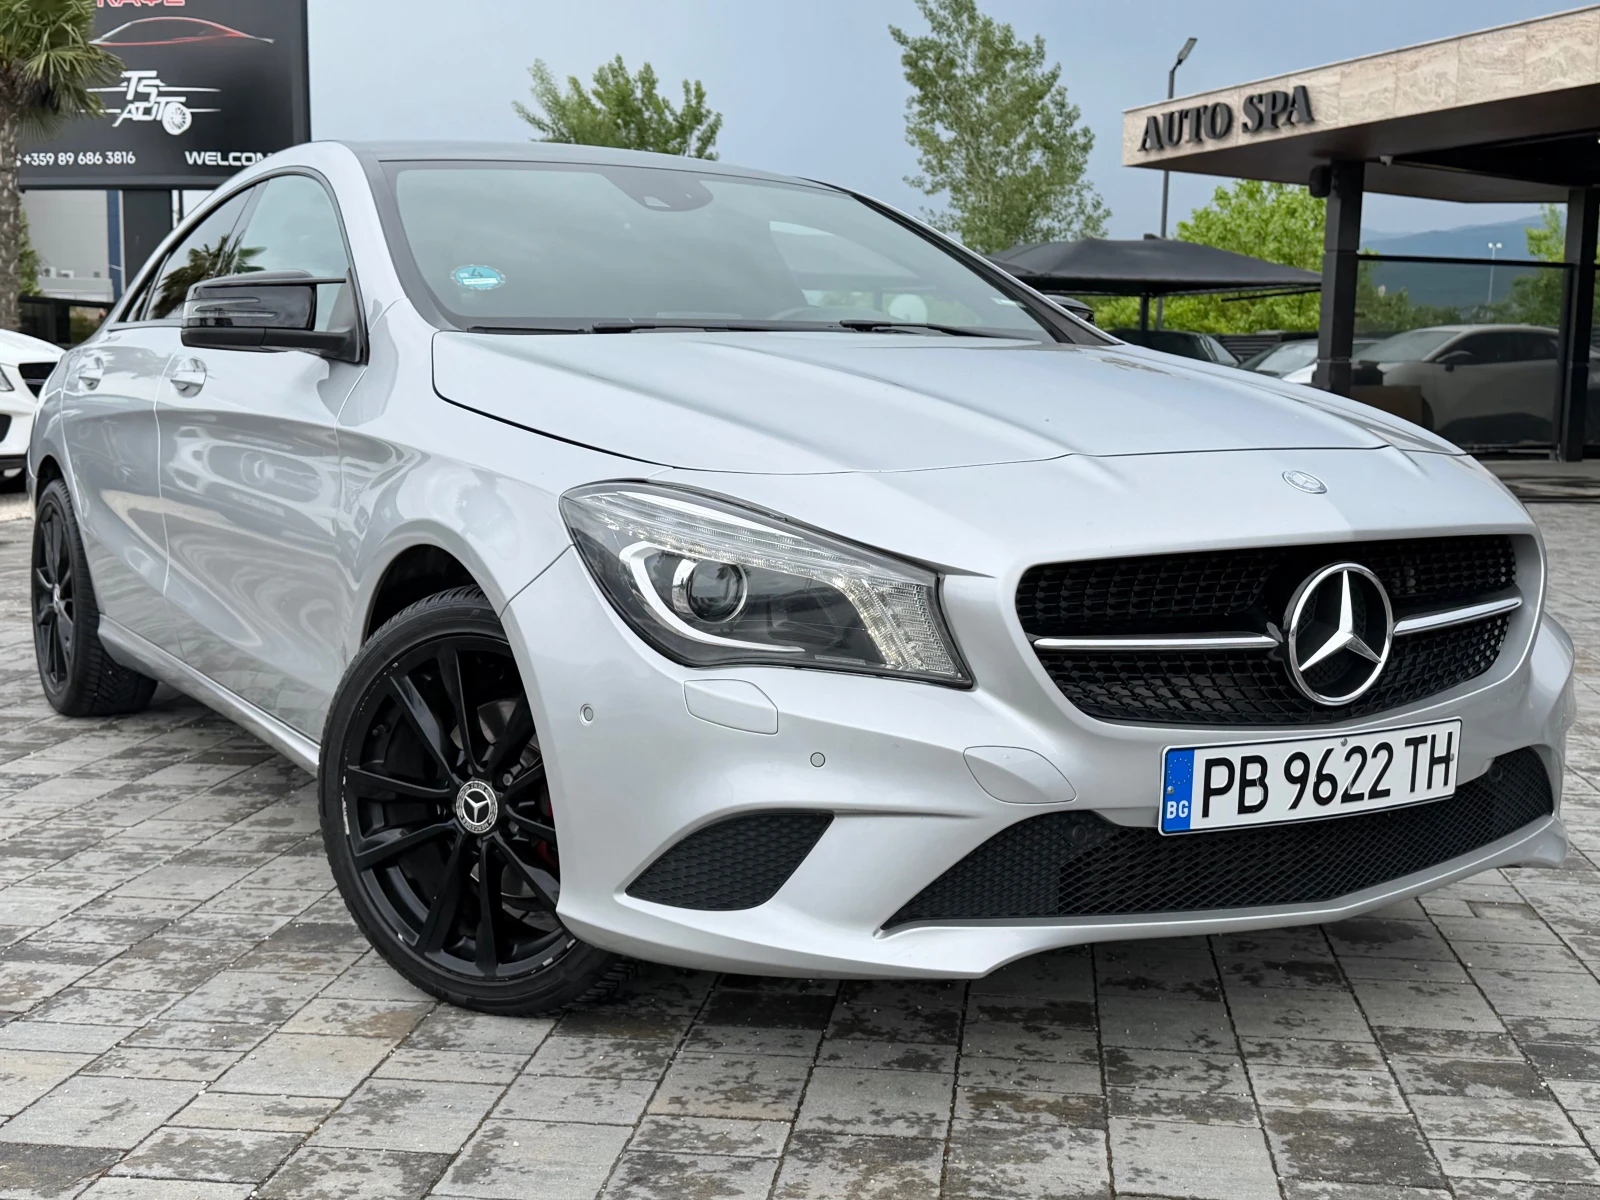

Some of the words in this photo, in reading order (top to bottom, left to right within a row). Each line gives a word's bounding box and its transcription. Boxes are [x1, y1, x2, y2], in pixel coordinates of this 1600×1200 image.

[121, 70, 161, 107] TS
[1137, 102, 1233, 151] AUTO
[1242, 85, 1314, 133] SPA
[23, 152, 55, 166] +359
[57, 152, 75, 166] 89
[77, 151, 103, 165] 686
[105, 151, 136, 165] 3816
[1202, 755, 1269, 818] PB
[1284, 741, 1394, 810] 9622
[1404, 731, 1453, 793] TH
[1166, 800, 1189, 819] BG
